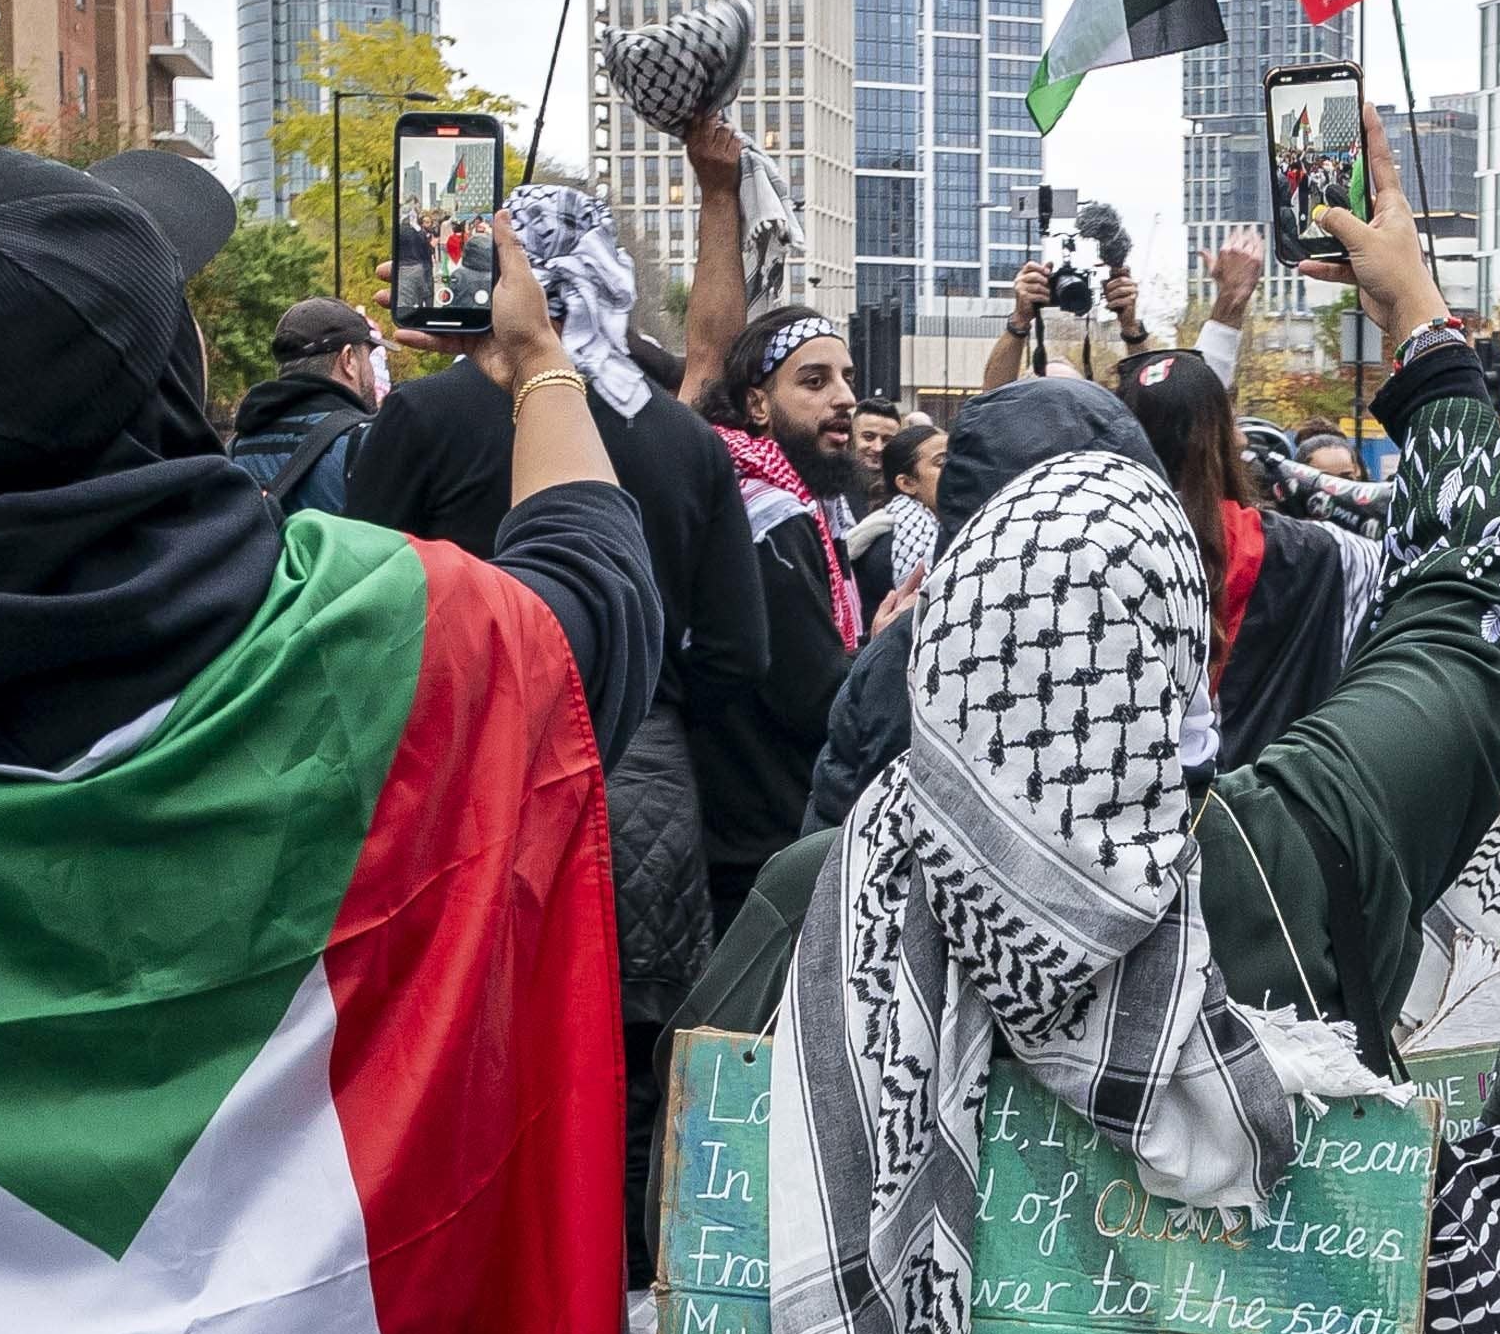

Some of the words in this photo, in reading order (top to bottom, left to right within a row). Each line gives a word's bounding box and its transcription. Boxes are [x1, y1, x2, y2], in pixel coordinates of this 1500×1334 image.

[696, 1140, 754, 1203] In
[1012, 1171, 1079, 1258] of
[1266, 1190, 1405, 1262] trees
[687, 1225, 772, 1288] Fro
[971, 1276, 1072, 1314] ver
[1088, 1249, 1161, 1317] to
[1165, 1261, 1273, 1331] the
